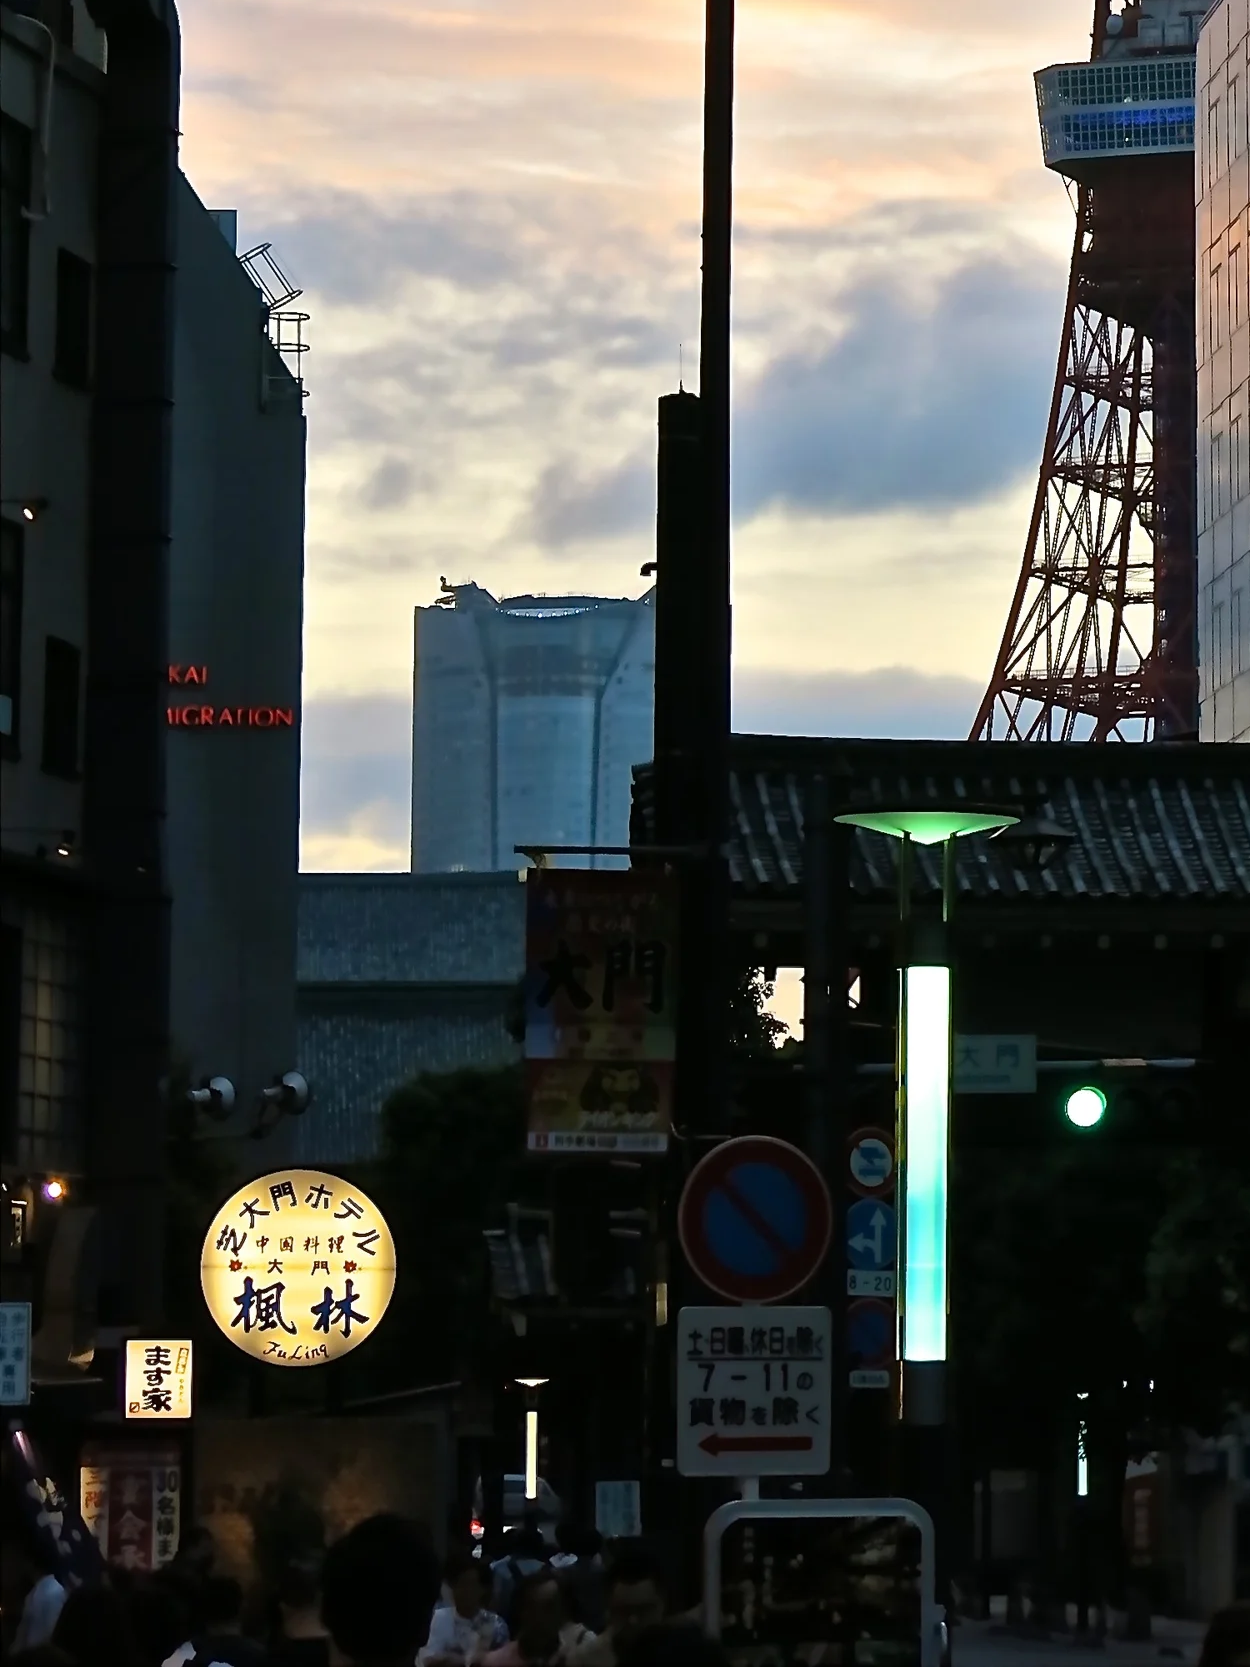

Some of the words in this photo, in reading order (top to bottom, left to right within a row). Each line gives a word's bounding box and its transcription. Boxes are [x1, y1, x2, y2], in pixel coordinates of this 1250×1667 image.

[536, 937, 667, 1014] 大門
[956, 1043, 1020, 1071] 大門
[216, 1180, 381, 1257] 芝大門ホテル
[267, 1258, 331, 1276] 大門
[230, 1275, 370, 1339] 楓林
[142, 1345, 173, 1413] ます家
